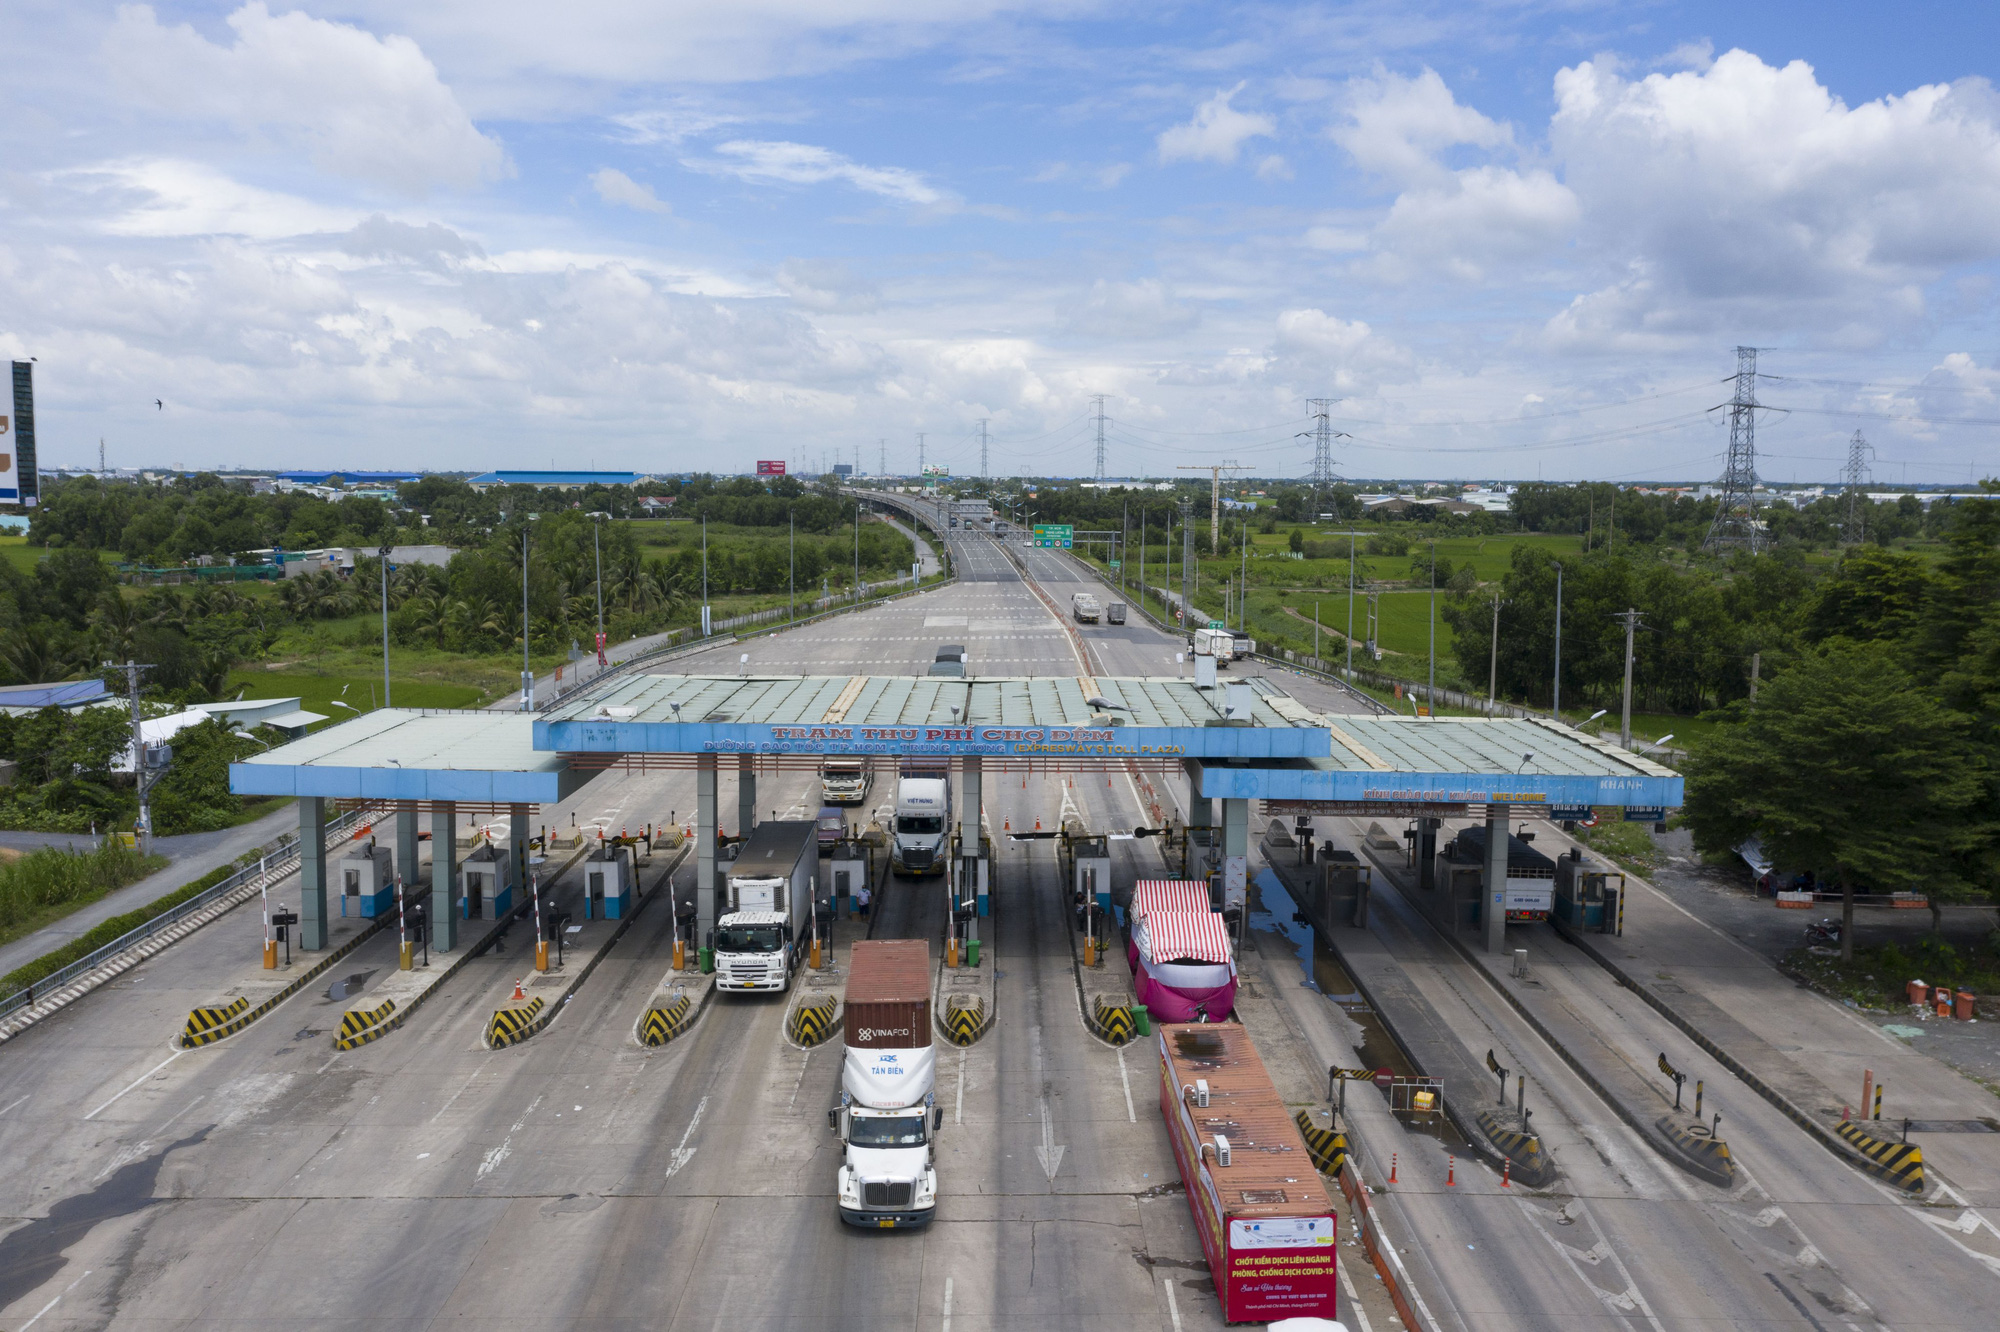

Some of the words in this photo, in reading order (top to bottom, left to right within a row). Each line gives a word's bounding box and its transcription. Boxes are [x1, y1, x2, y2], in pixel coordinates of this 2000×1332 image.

[772, 727, 854, 742] TRẠM
[861, 728, 920, 740] THU
[924, 726, 974, 741] PHÍ
[982, 729, 1044, 744] CHỢ
[1051, 727, 1115, 744] ĐỆM
[704, 739, 756, 750] ĐƯỜNG
[761, 743, 791, 751] CAO
[795, 739, 824, 751] TỐC
[829, 742, 887, 752] TP.HCM
[901, 743, 950, 752] TRUNG
[956, 743, 1005, 753] LƯƠNG
[1014, 743, 1104, 754] (EXPRESWAY'S
[1106, 745, 1137, 754] TOLL
[1141, 745, 1186, 754] PLAZA)
[1363, 787, 1390, 800] KÍNH
[1392, 788, 1421, 800] CHÀO
[1424, 789, 1445, 800] QUÝ
[1449, 788, 1486, 801] KHÁCH
[1492, 792, 1546, 802] WELCOME
[871, 1028, 909, 1036] VINAFCO
[1235, 1256, 1253, 1266] CHỐT
[1272, 1257, 1289, 1266] DỊCH
[1290, 1255, 1304, 1263] LIÊN
[1306, 1255, 1330, 1263] NGÀNH
[1232, 1269, 1258, 1277] PHÒNG,
[1260, 1267, 1283, 1276] CHỐNG
[1284, 1268, 1301, 1277] DỊCH
